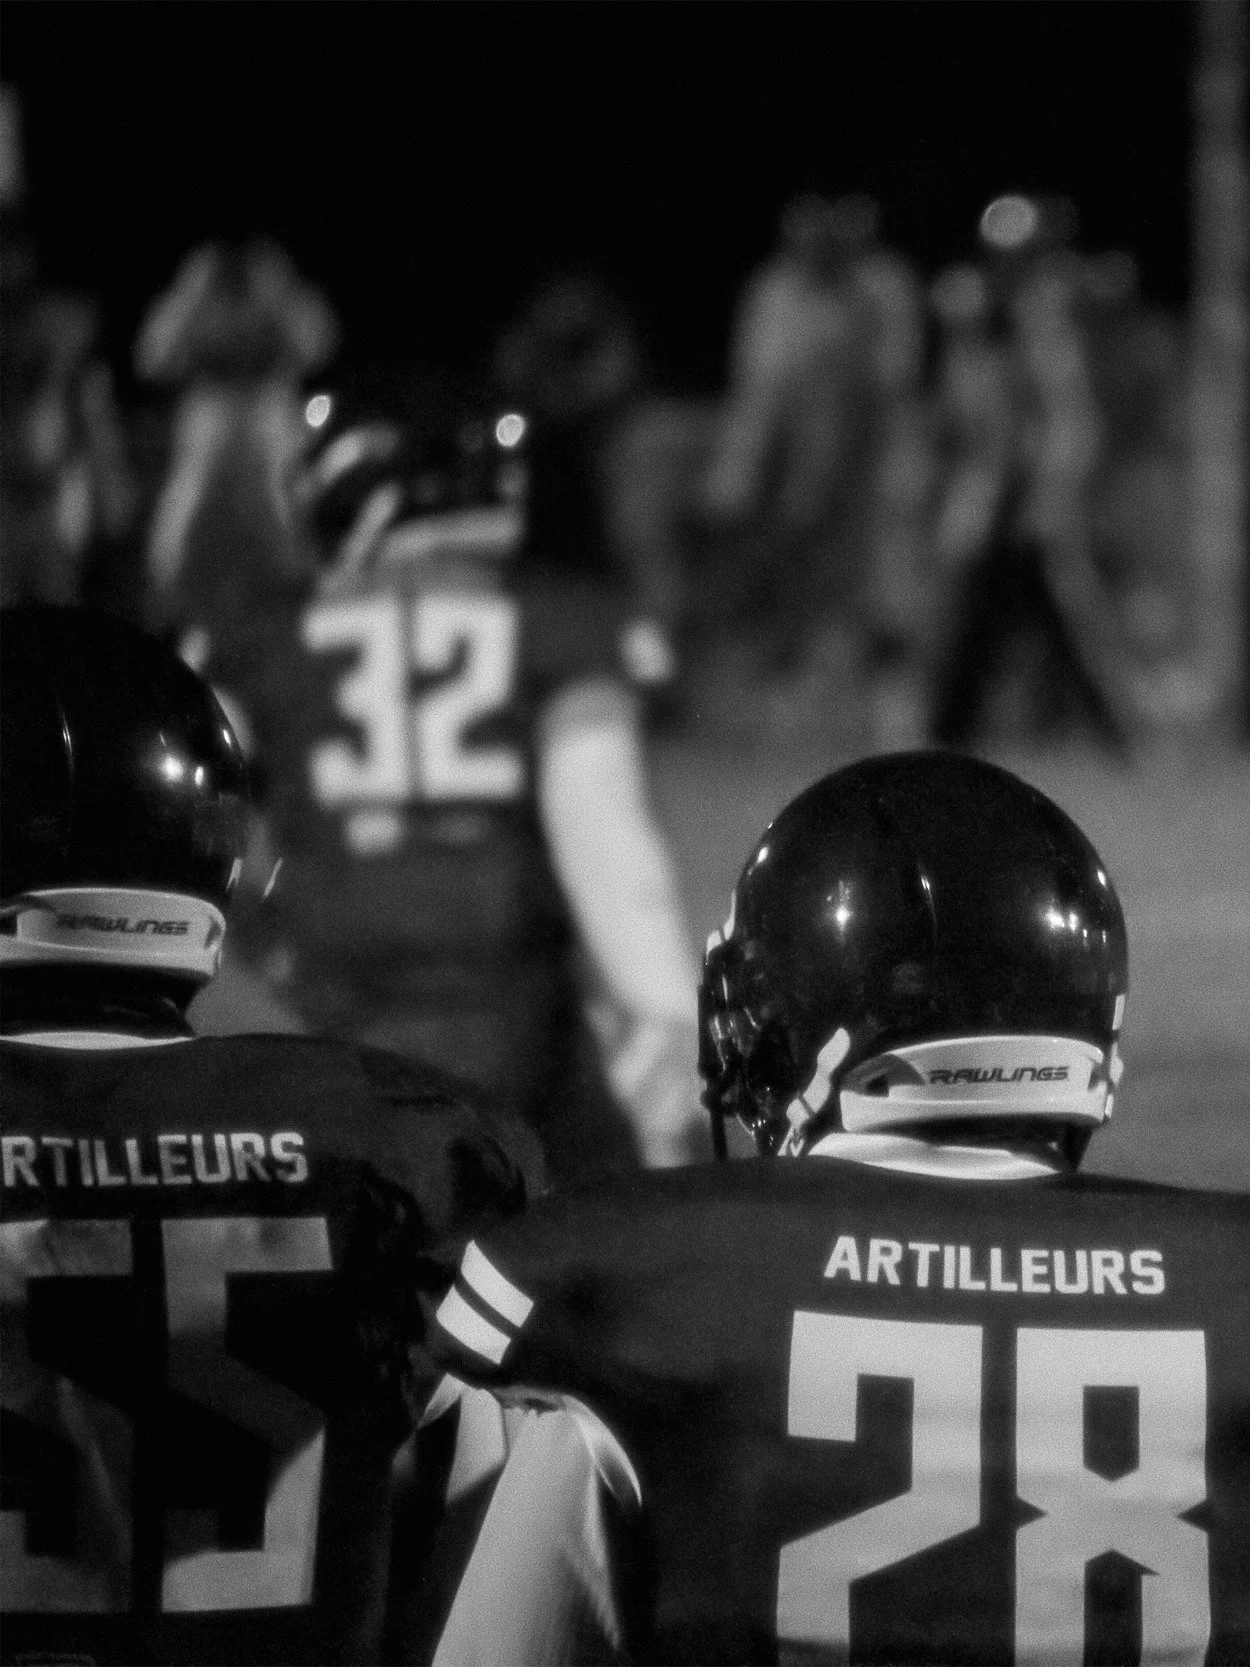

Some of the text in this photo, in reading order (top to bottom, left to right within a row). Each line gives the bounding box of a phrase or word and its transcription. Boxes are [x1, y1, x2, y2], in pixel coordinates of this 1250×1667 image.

[928, 1066, 1069, 1085] RAWLINGS
[0, 1132, 309, 1187] RTILLEURS
[824, 1235, 1166, 1295] ARTILLEURS
[0, 1217, 334, 1614] 55
[776, 1310, 1212, 1667] 28
